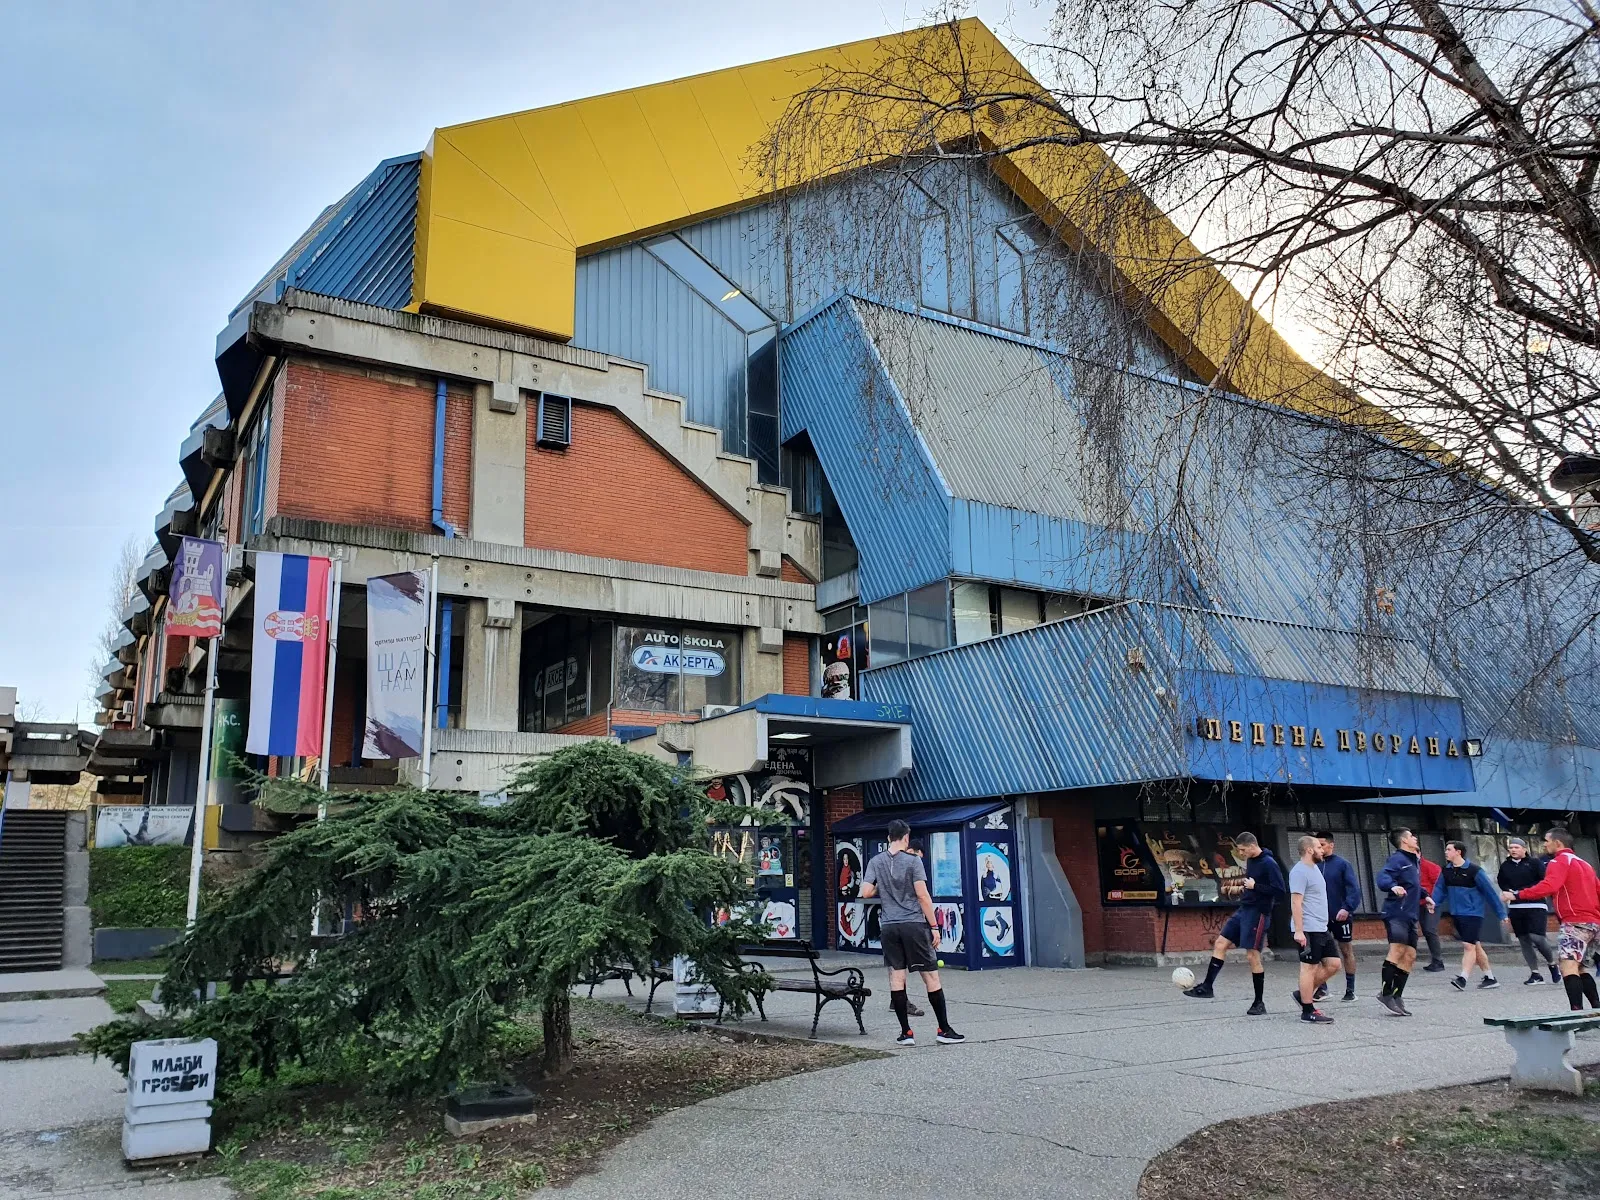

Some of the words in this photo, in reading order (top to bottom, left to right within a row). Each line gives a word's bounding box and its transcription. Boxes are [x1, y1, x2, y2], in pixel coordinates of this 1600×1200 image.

[644, 633, 680, 644] AUTO
[683, 635, 724, 648] ŠKOLA
[663, 655, 715, 669] AKCEPTA
[1206, 718, 1325, 748] ЛЕДЕНА
[1337, 729, 1460, 758] ДВОРАНА
[764, 761, 795, 770] ЕДЕНА
[1341, 923, 1351, 935] 11
